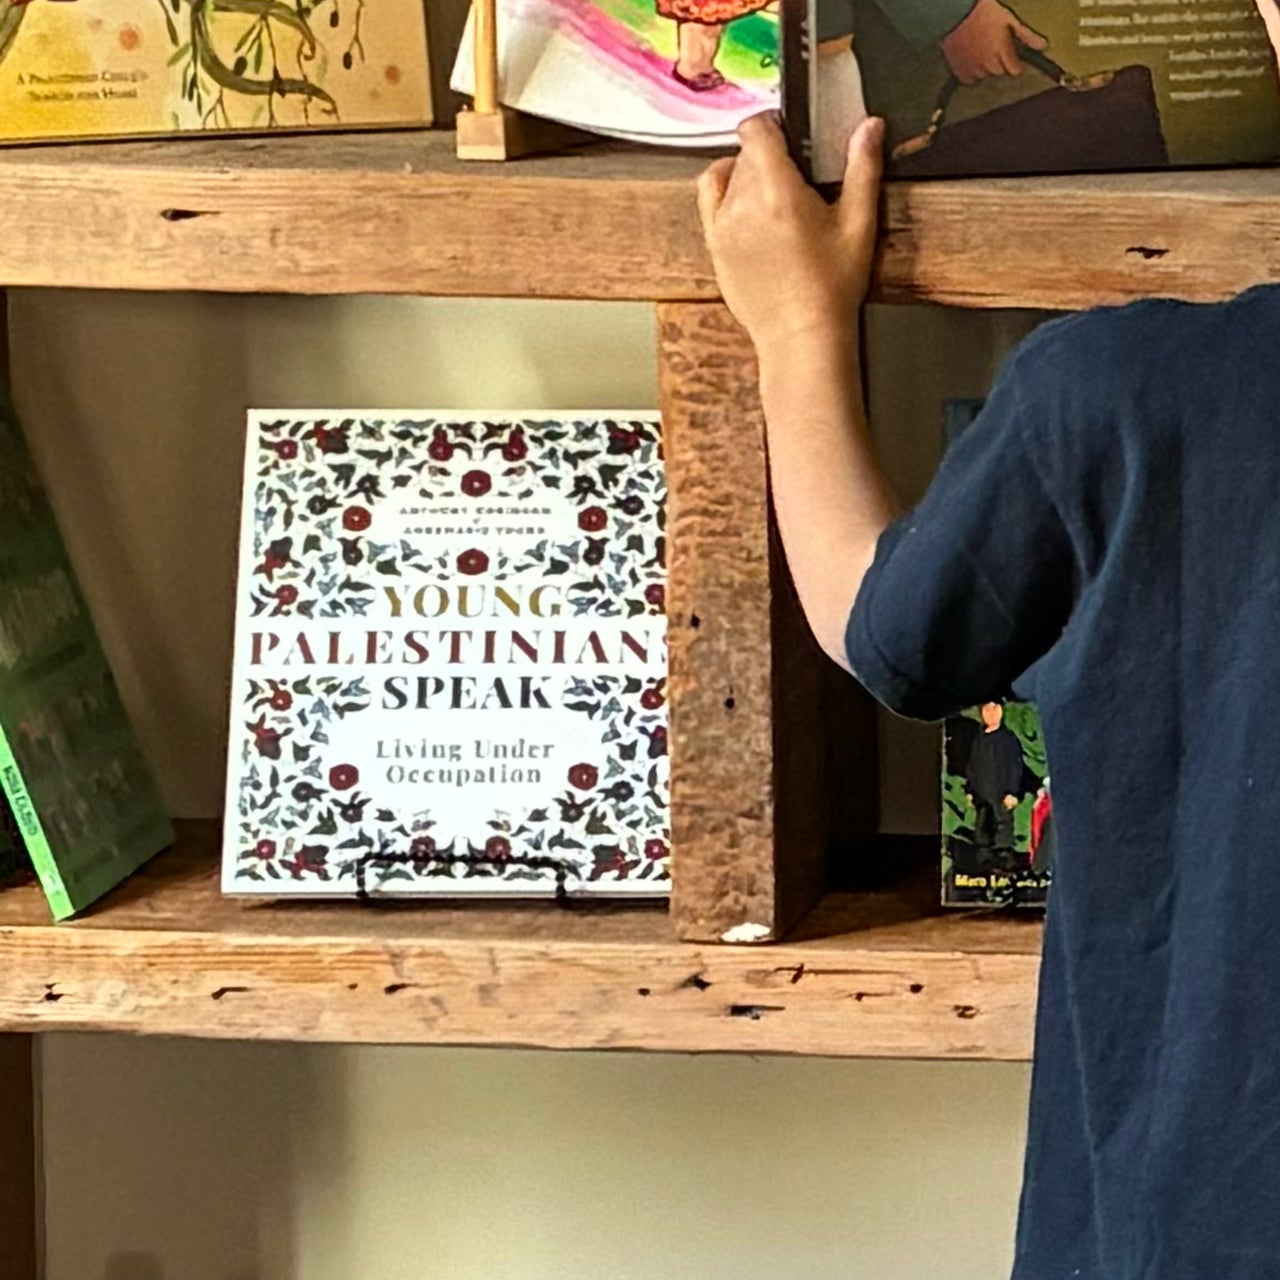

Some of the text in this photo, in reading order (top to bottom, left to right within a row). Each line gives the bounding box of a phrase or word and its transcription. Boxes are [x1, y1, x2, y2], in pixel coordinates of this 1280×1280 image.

[382, 585, 563, 618] YOUNG
[381, 675, 554, 711] SPEAK
[376, 738, 555, 763] Living Under
[385, 764, 542, 788] Occupation
